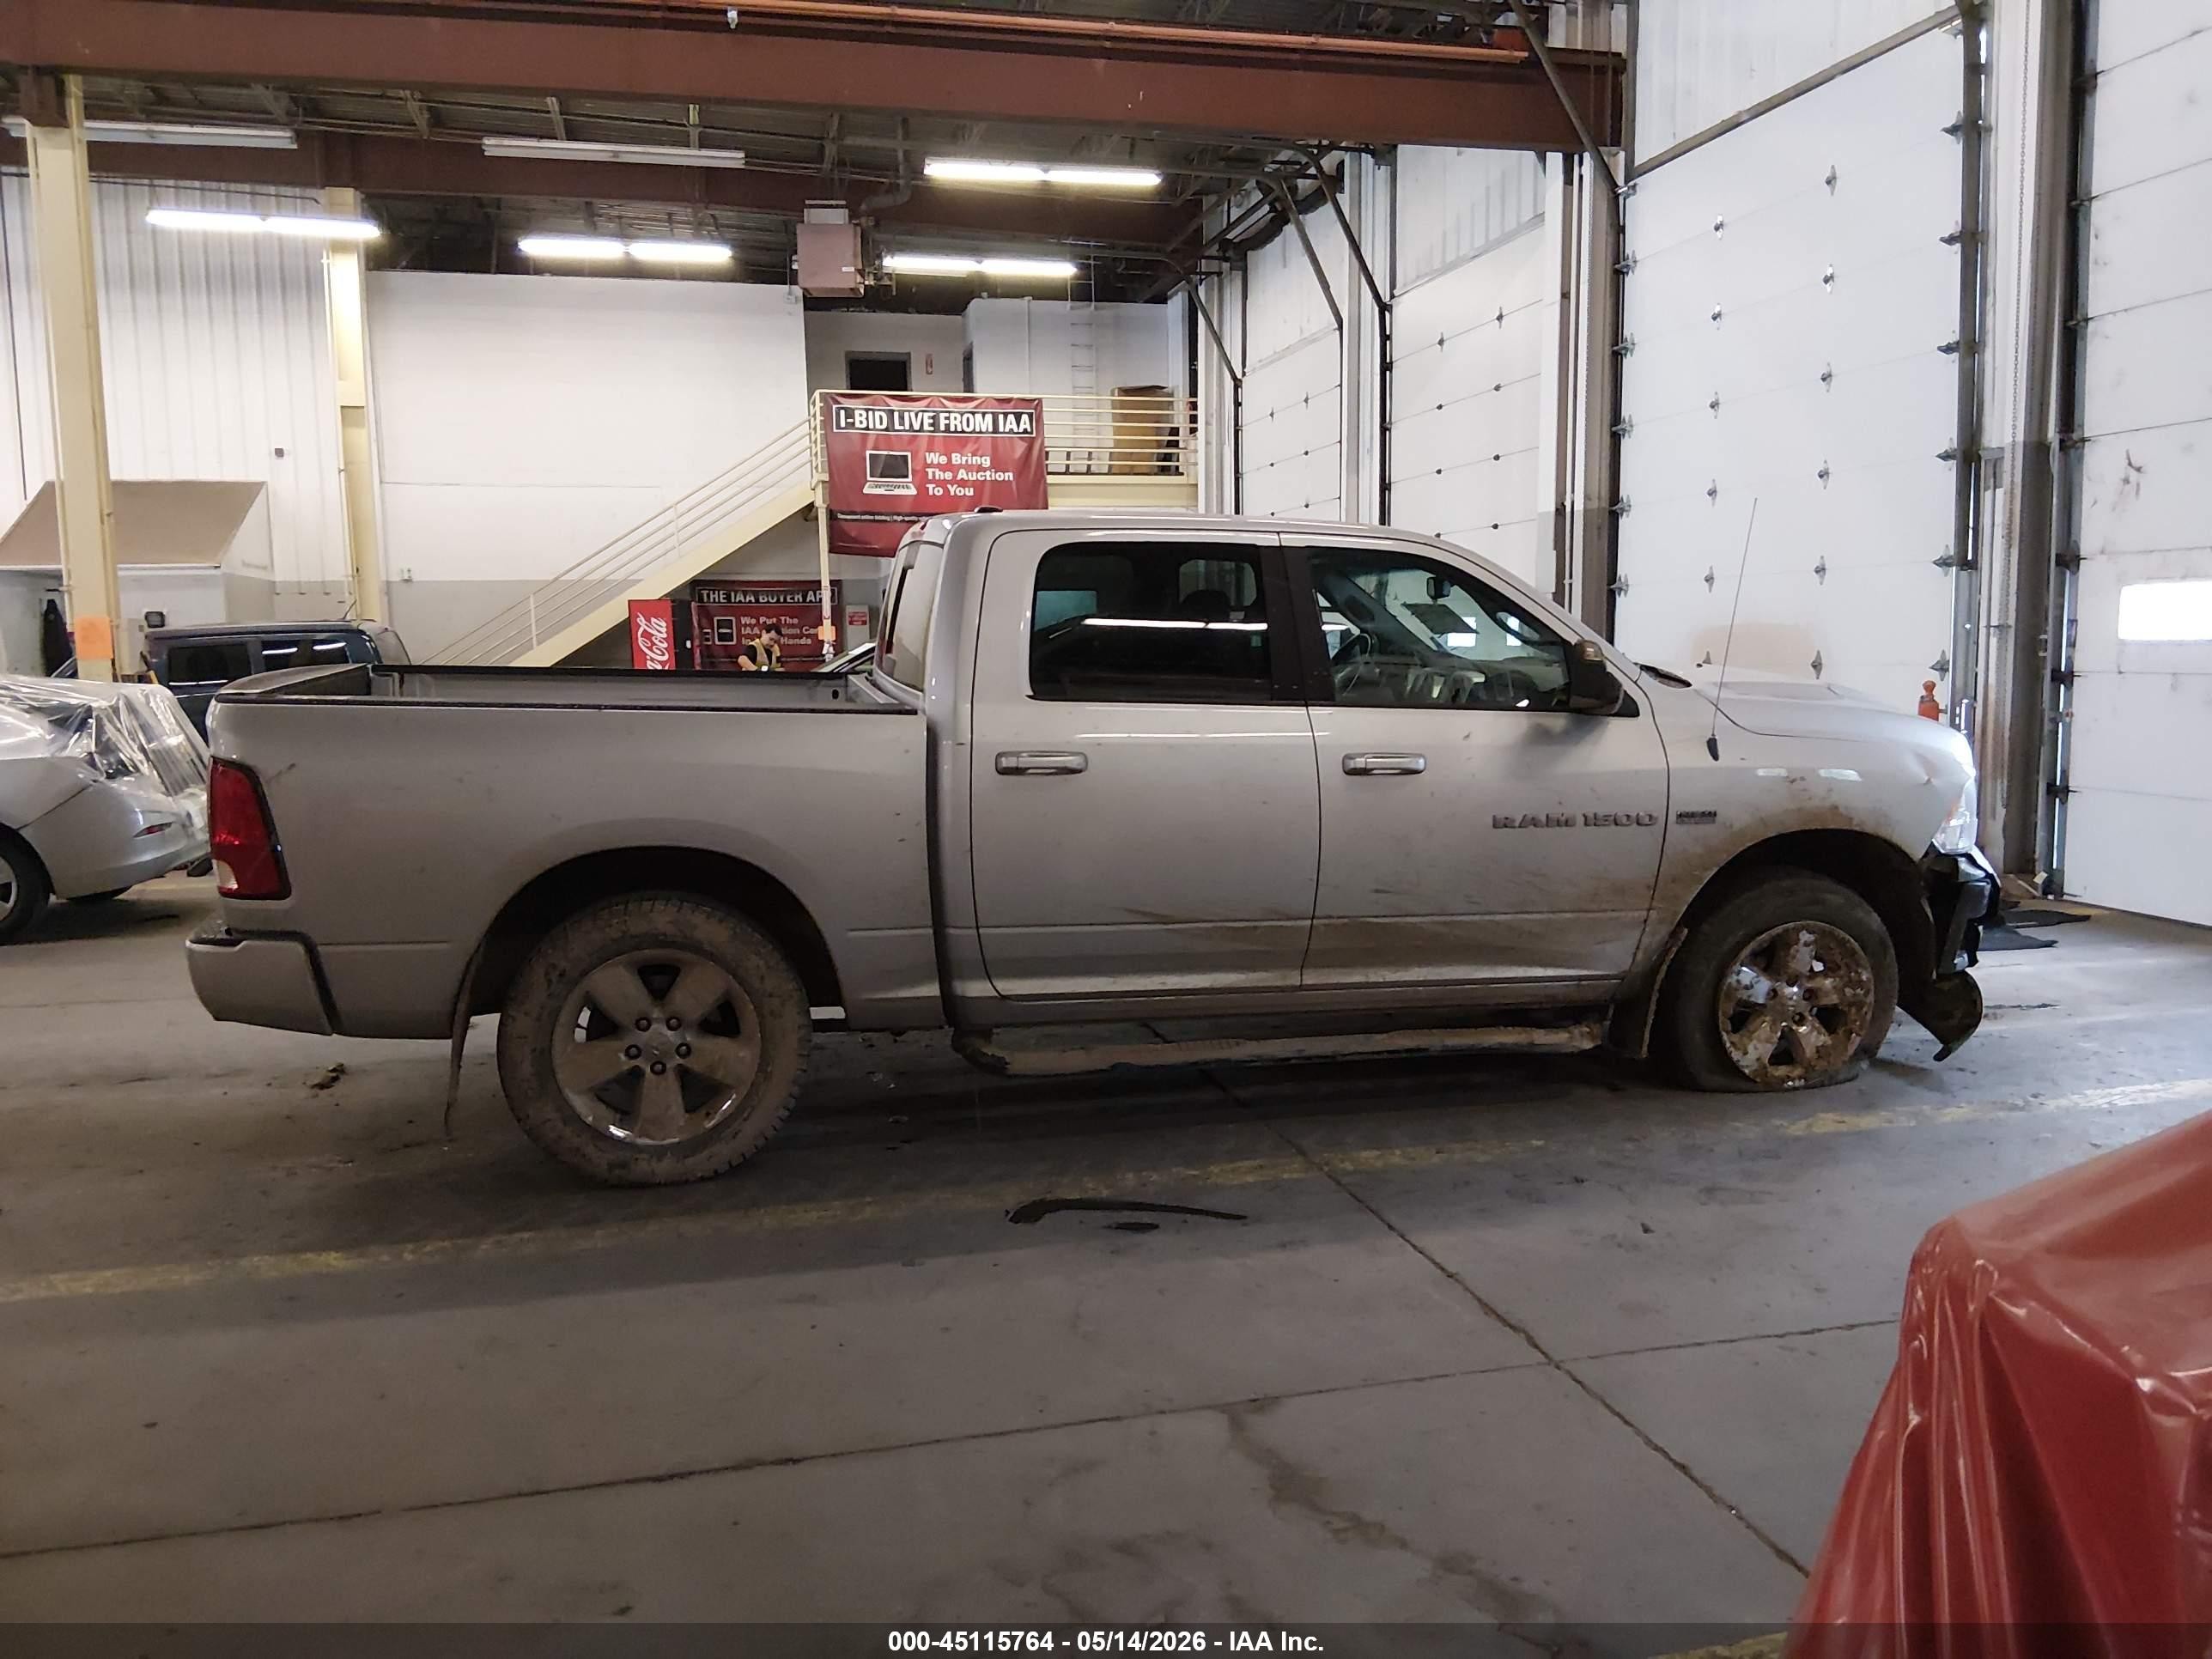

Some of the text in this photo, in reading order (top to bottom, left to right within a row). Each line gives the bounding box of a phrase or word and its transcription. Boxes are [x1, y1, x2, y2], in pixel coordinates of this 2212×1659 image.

[840, 409, 1031, 433] I-BID LIVE FROM IAA
[925, 452, 991, 467] We Bring
[926, 468, 1013, 481] The Auction
[927, 484, 974, 496] To You
[701, 590, 727, 603] THE
[731, 590, 756, 603] IAA
[806, 590, 831, 603] AP
[740, 616, 757, 624] We
[741, 626, 761, 635] IAA
[1492, 812, 1577, 830] RAM
[1582, 811, 1657, 828] 1500
